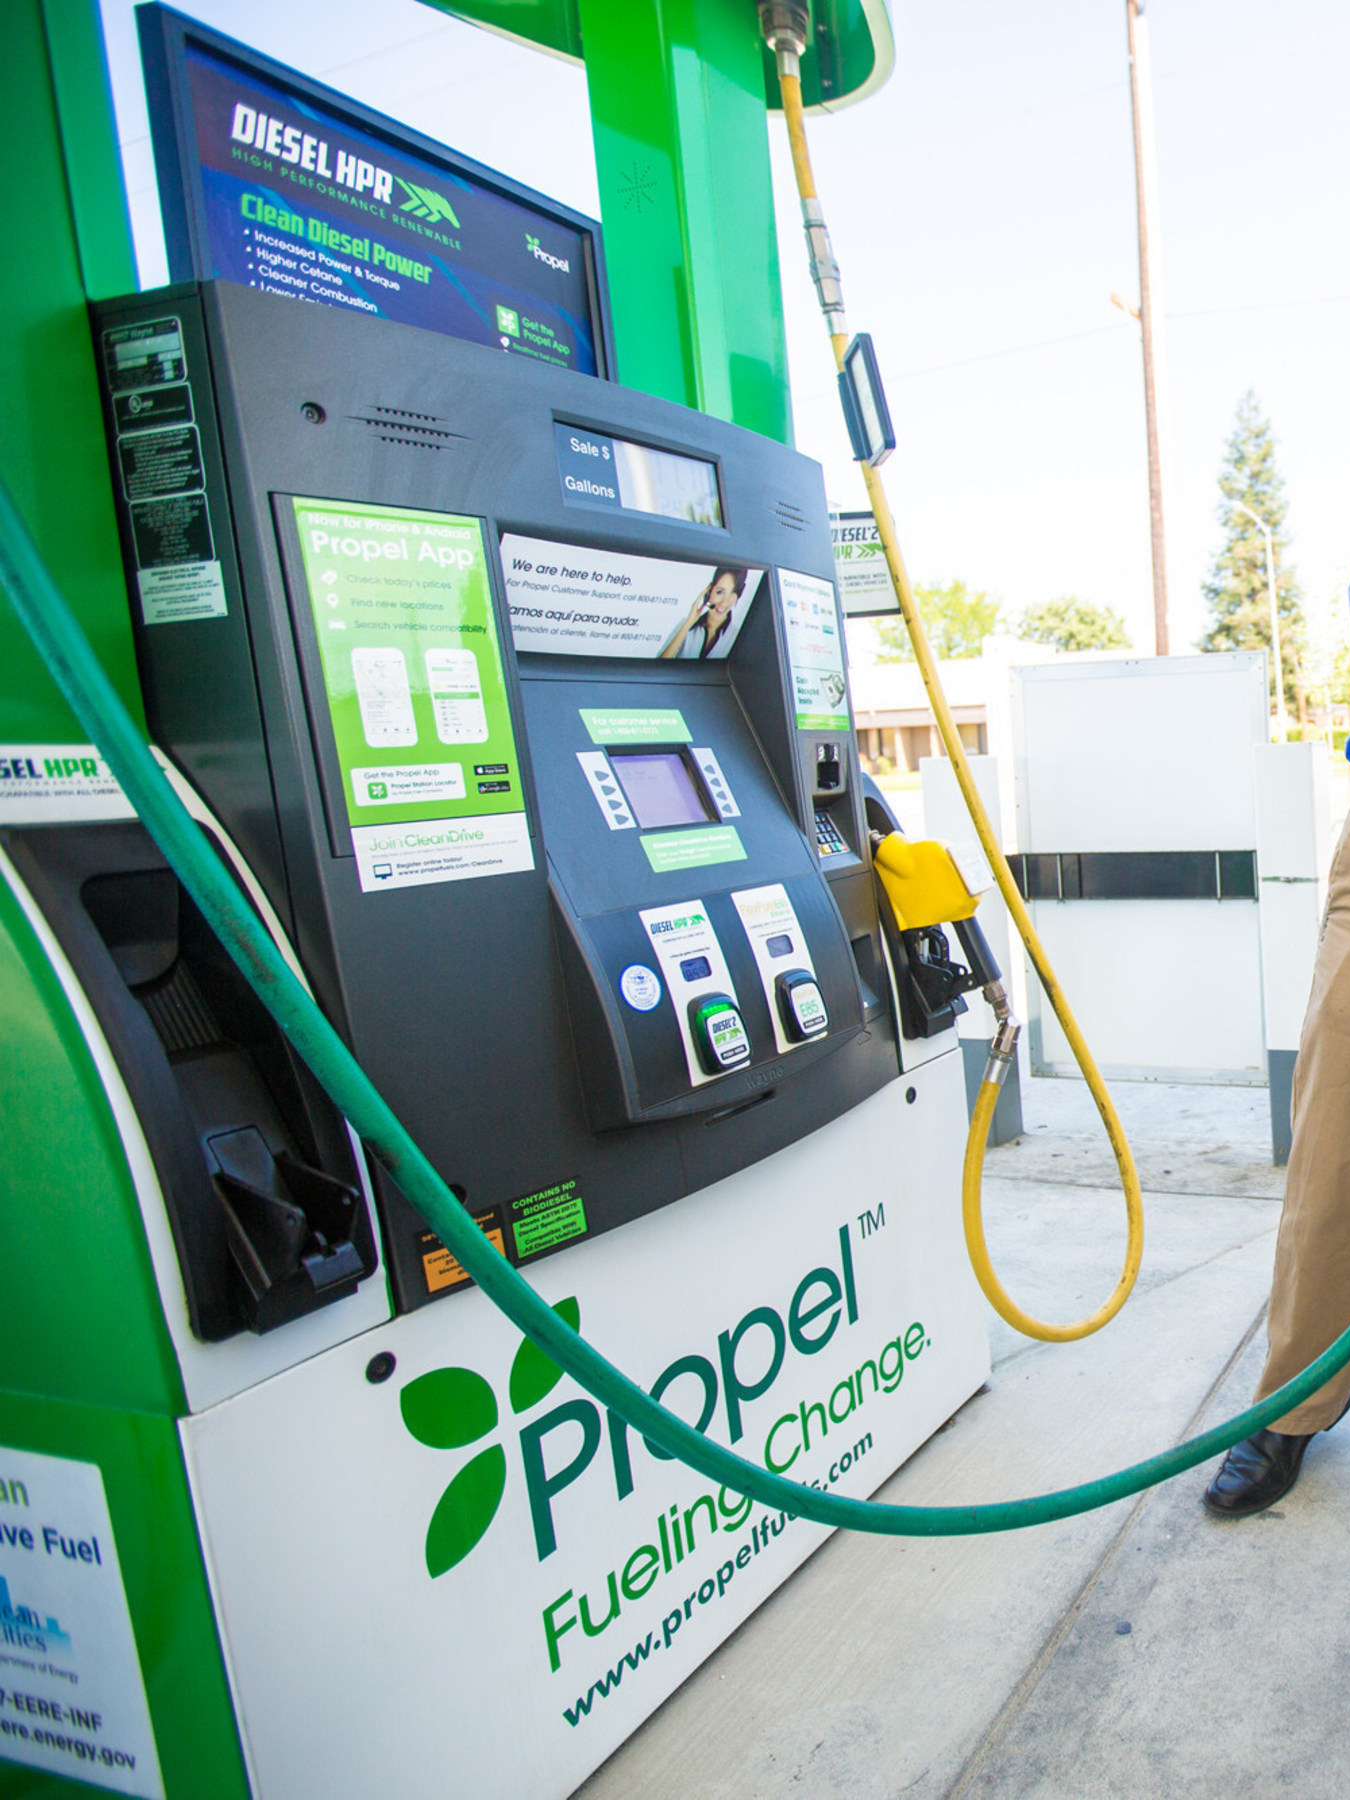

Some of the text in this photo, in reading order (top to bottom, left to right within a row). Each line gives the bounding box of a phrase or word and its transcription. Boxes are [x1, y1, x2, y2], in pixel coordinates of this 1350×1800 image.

[230, 102, 394, 205] DIESEL HPR
[232, 147, 462, 251] HIGH PERFORMANCE RENEWABLE
[241, 193, 433, 284] Clean Diesel Power
[254, 230, 401, 292] Increased Power & Torque
[256, 247, 343, 286] Higher Cetane
[533, 245, 571, 273] Propel
[258, 264, 308, 290] Cleaner
[310, 281, 378, 313] Combustion
[521, 317, 540, 331] Get
[523, 329, 571, 356] Propel App
[570, 437, 611, 461] Sale $
[565, 476, 616, 499] Gallons
[311, 530, 474, 569] Propel App
[346, 574, 452, 591] Check today's prices
[512, 557, 633, 587] We are here to help.
[506, 578, 521, 588] For
[521, 580, 550, 592] Propel
[551, 584, 591, 597] Customer
[622, 593, 637, 602] call
[351, 597, 444, 611] Find new locations
[354, 620, 390, 630] Search
[393, 622, 428, 632] vehicle
[545, 609, 573, 622] aquí
[571, 613, 600, 624] para
[550, 626, 560, 635] al
[44, 757, 99, 779] HPR
[364, 768, 440, 780] Get the Propel App
[369, 837, 404, 851] Join
[404, 828, 484, 848] CleanDrive
[650, 920, 673, 935] DIESEL
[799, 1000, 819, 1018] E85
[713, 1018, 731, 1034] DIESEL
[512, 1180, 576, 1209] CONTAINS NO
[522, 1193, 573, 1216] BIODIESEL
[519, 1223, 860, 1563] Propel
[542, 1321, 933, 1673] Fueling Change.
[42, 1526, 102, 1566] Fuel
